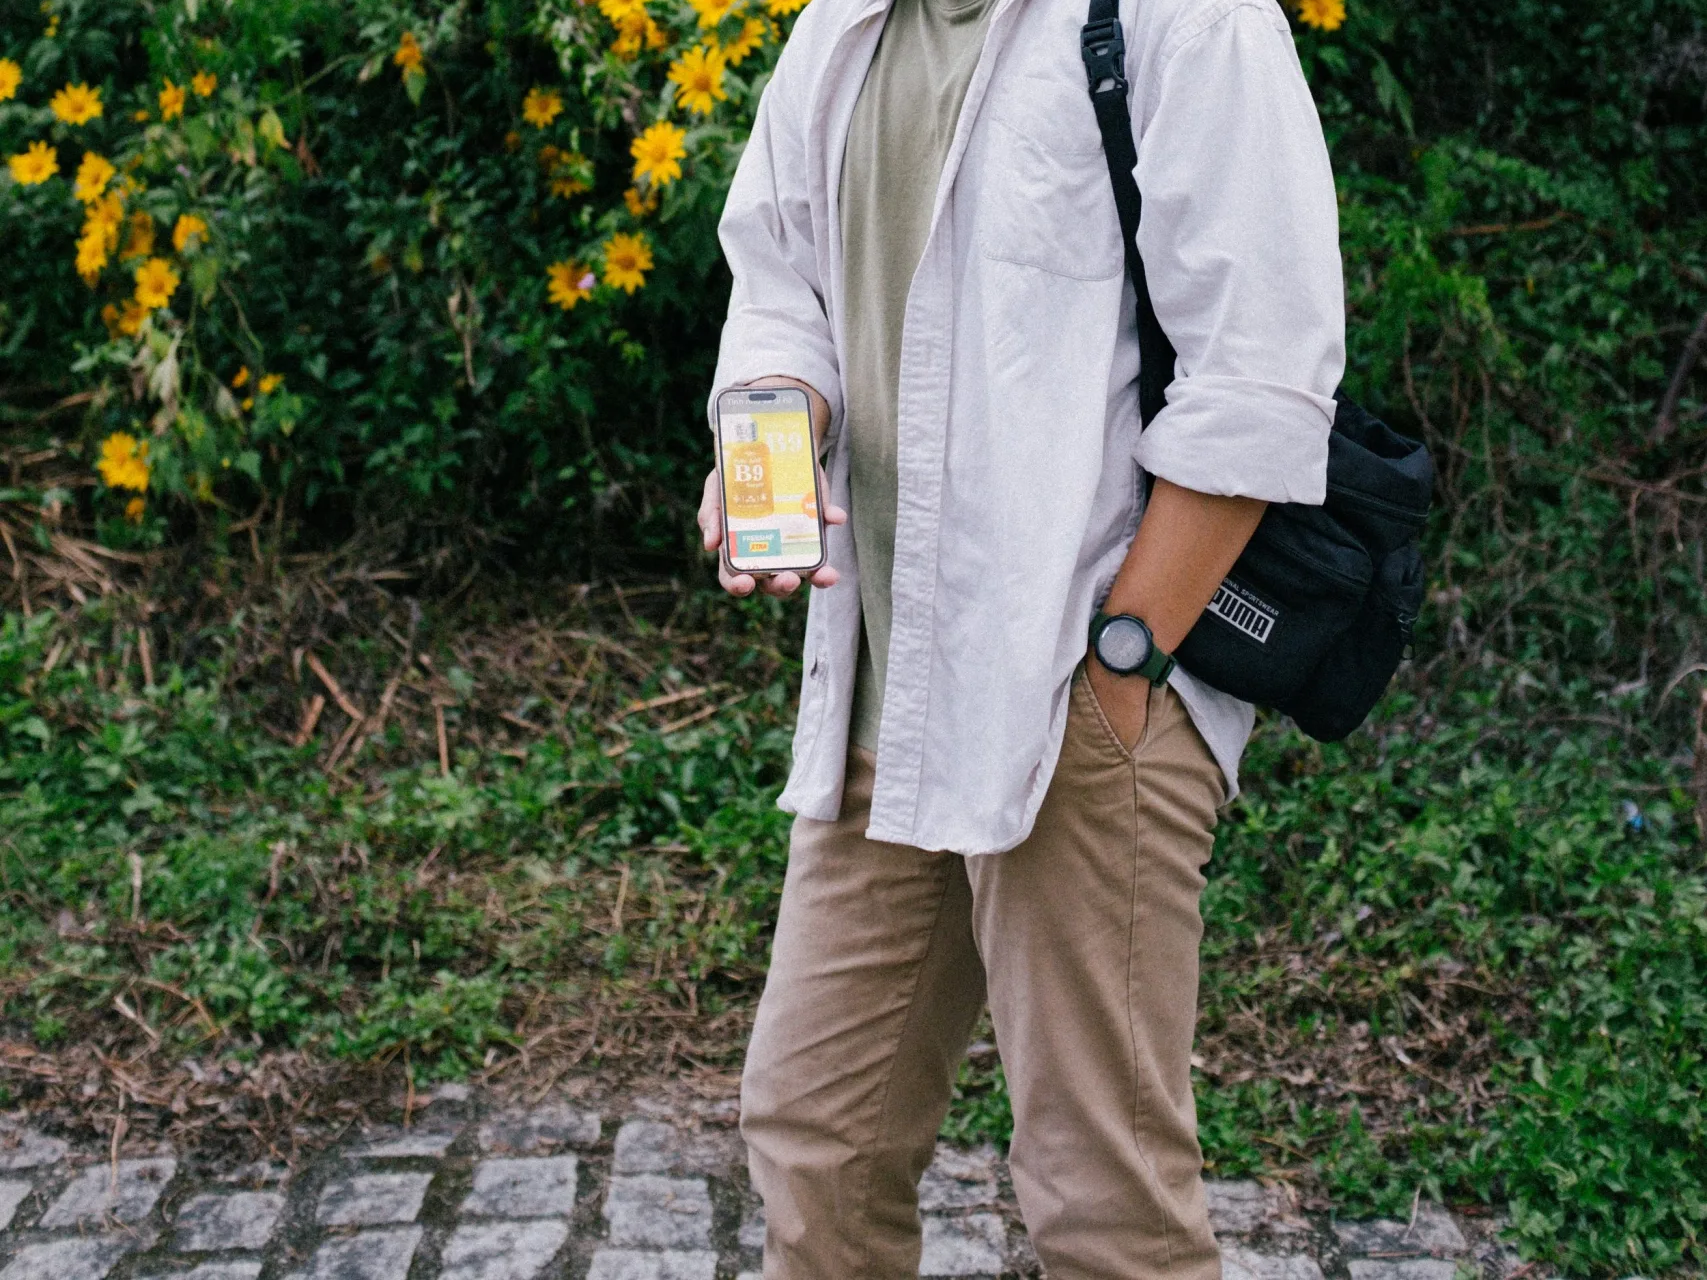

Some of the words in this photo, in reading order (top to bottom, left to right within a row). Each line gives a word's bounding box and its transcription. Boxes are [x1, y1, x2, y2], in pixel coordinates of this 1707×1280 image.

[765, 432, 802, 453] B9
[734, 464, 763, 482] B9
[751, 544, 767, 552] XTRA
[1223, 577, 1240, 592] GINAL
[1240, 588, 1280, 617] SPORTSWEAR
[1207, 587, 1271, 639] PUMA
